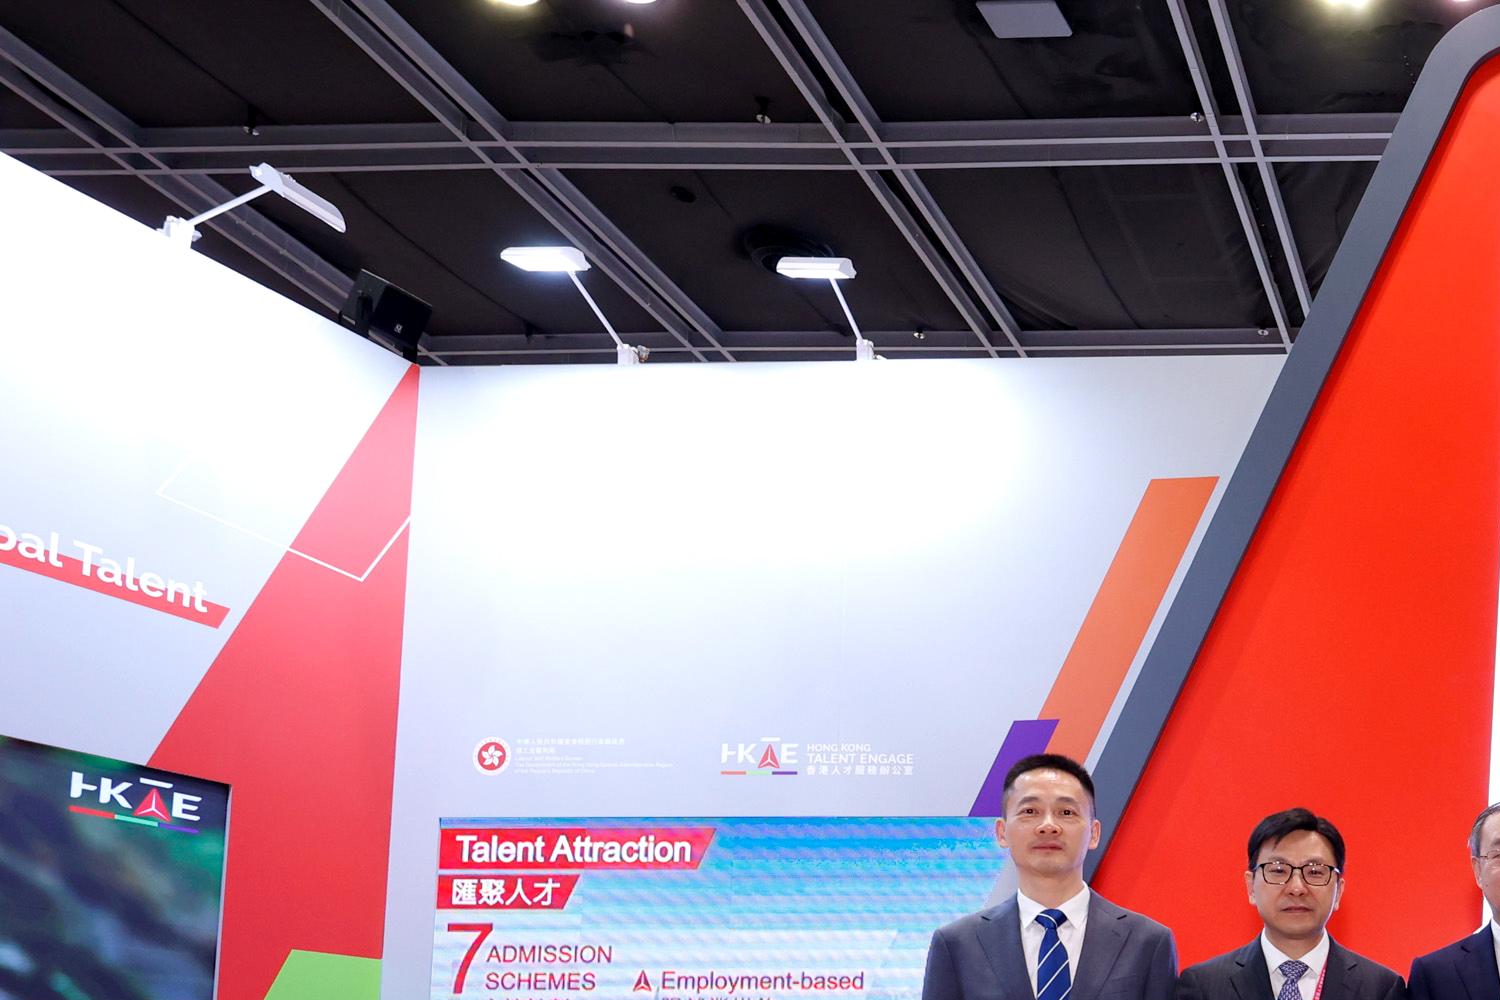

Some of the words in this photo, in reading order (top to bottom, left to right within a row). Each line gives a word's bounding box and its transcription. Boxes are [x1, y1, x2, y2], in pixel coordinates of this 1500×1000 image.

[73, 539, 208, 613] Talent
[807, 744, 838, 752] HONG
[840, 744, 871, 752] KONG
[807, 753, 857, 765] TALENT
[859, 753, 914, 765] ENGAGE
[455, 834, 545, 863] Talent
[549, 834, 692, 863] Attraction
[451, 877, 561, 907] 匯聚人才
[446, 923, 494, 995] 7
[486, 945, 613, 964] ADMISSION
[485, 972, 597, 991] SCHEMES
[661, 971, 864, 994] Employment-based
